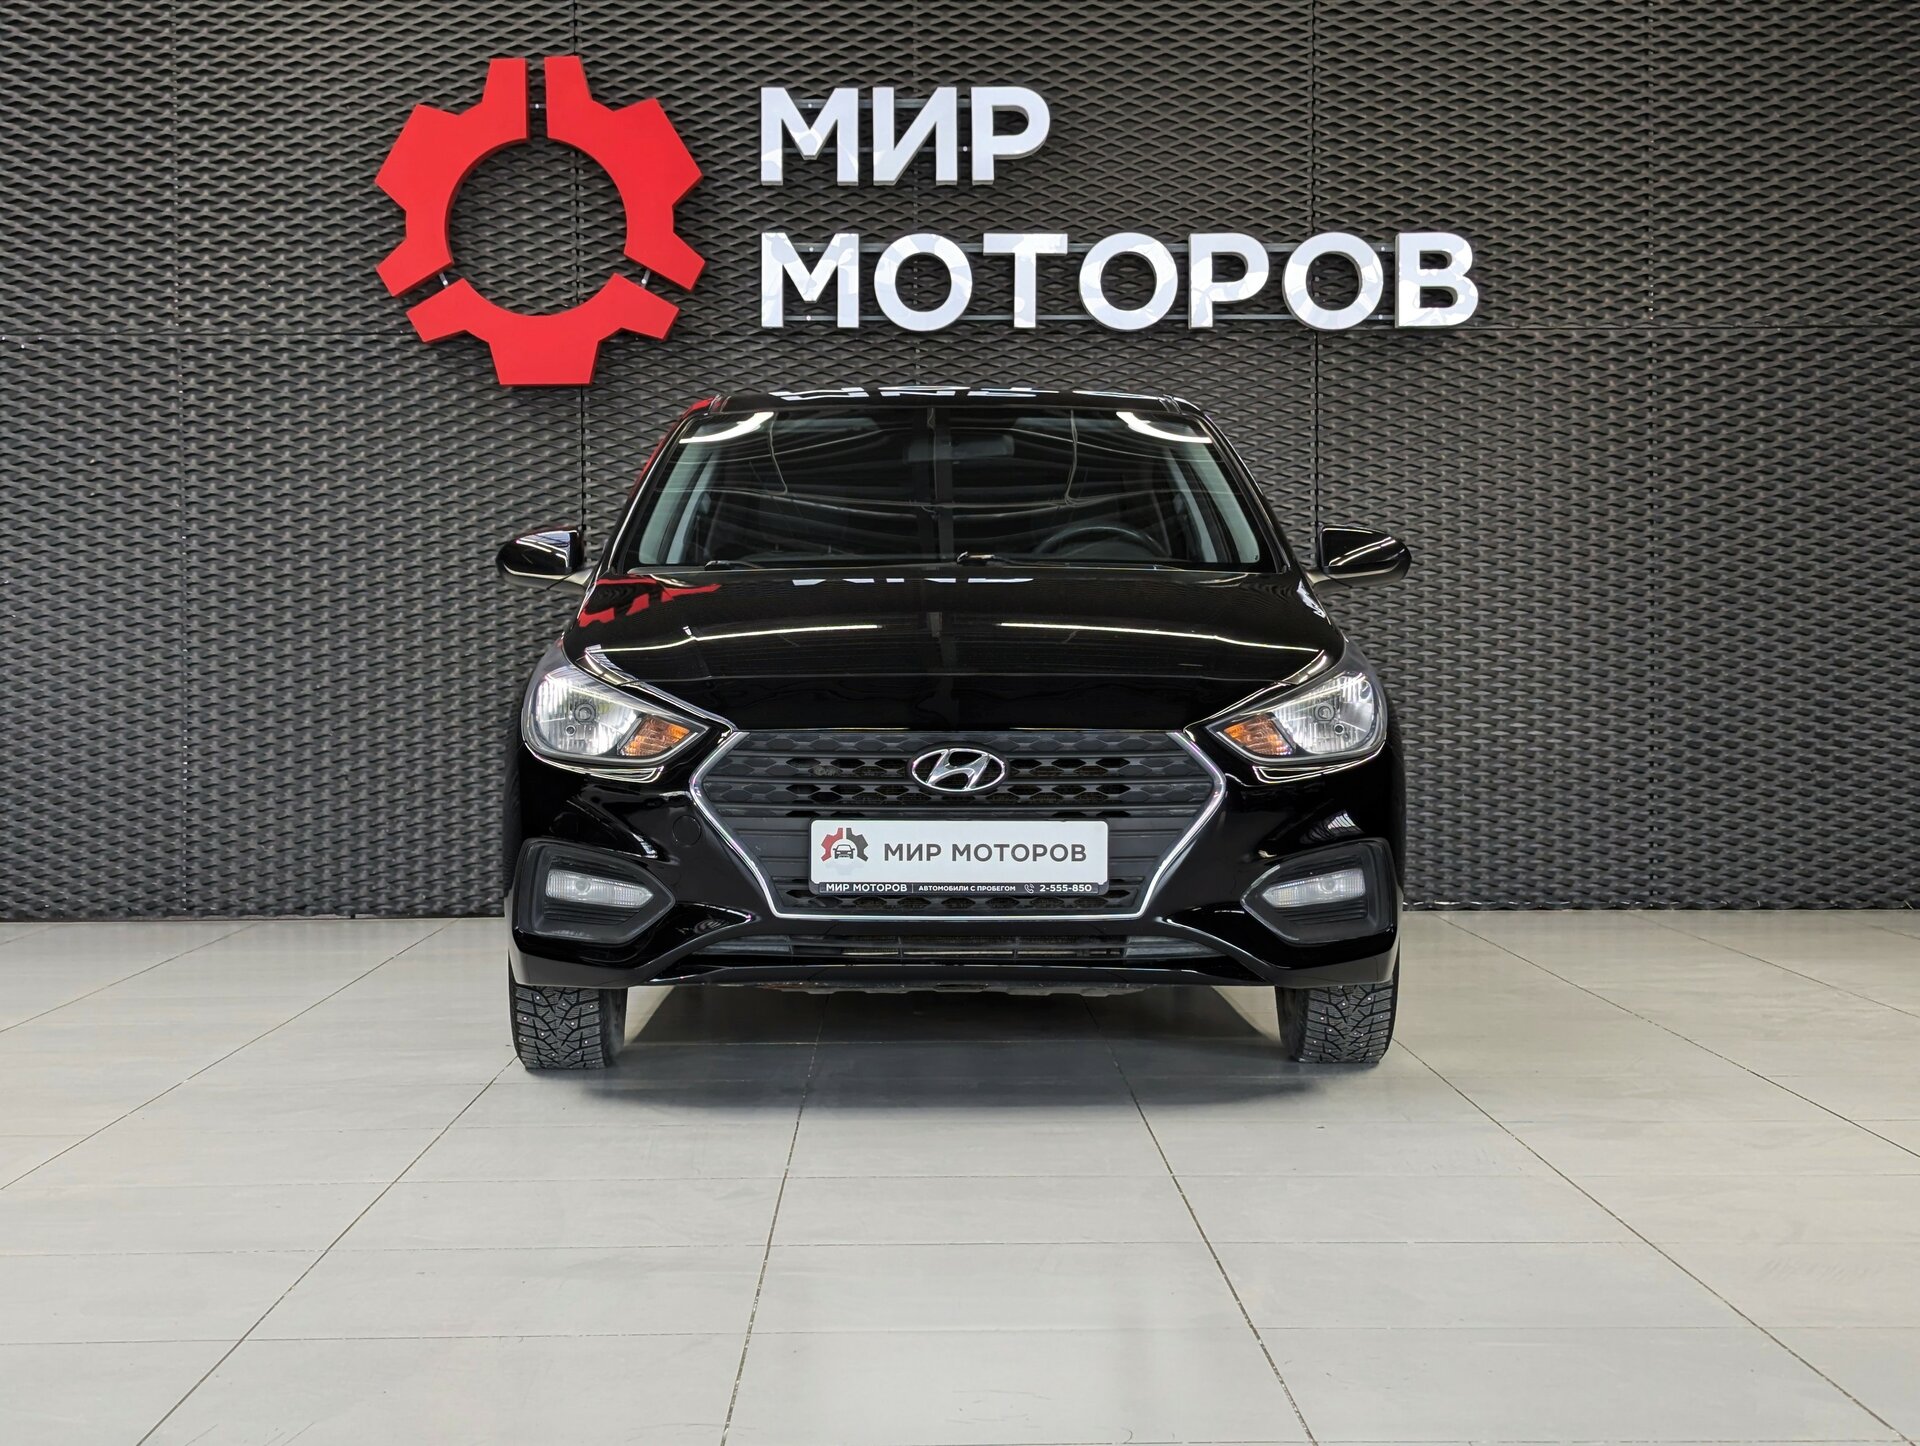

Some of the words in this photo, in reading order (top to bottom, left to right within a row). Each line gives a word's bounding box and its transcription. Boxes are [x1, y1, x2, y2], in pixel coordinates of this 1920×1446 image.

[760, 86, 1051, 185] МИР
[760, 232, 1480, 331] МОТОРОВ
[884, 843, 942, 862] МИР
[951, 843, 1087, 862] МОТОРОВ
[826, 883, 850, 892] МИР
[853, 883, 907, 892] МОТОРОВ
[1039, 884, 1092, 892] 2-555-850
